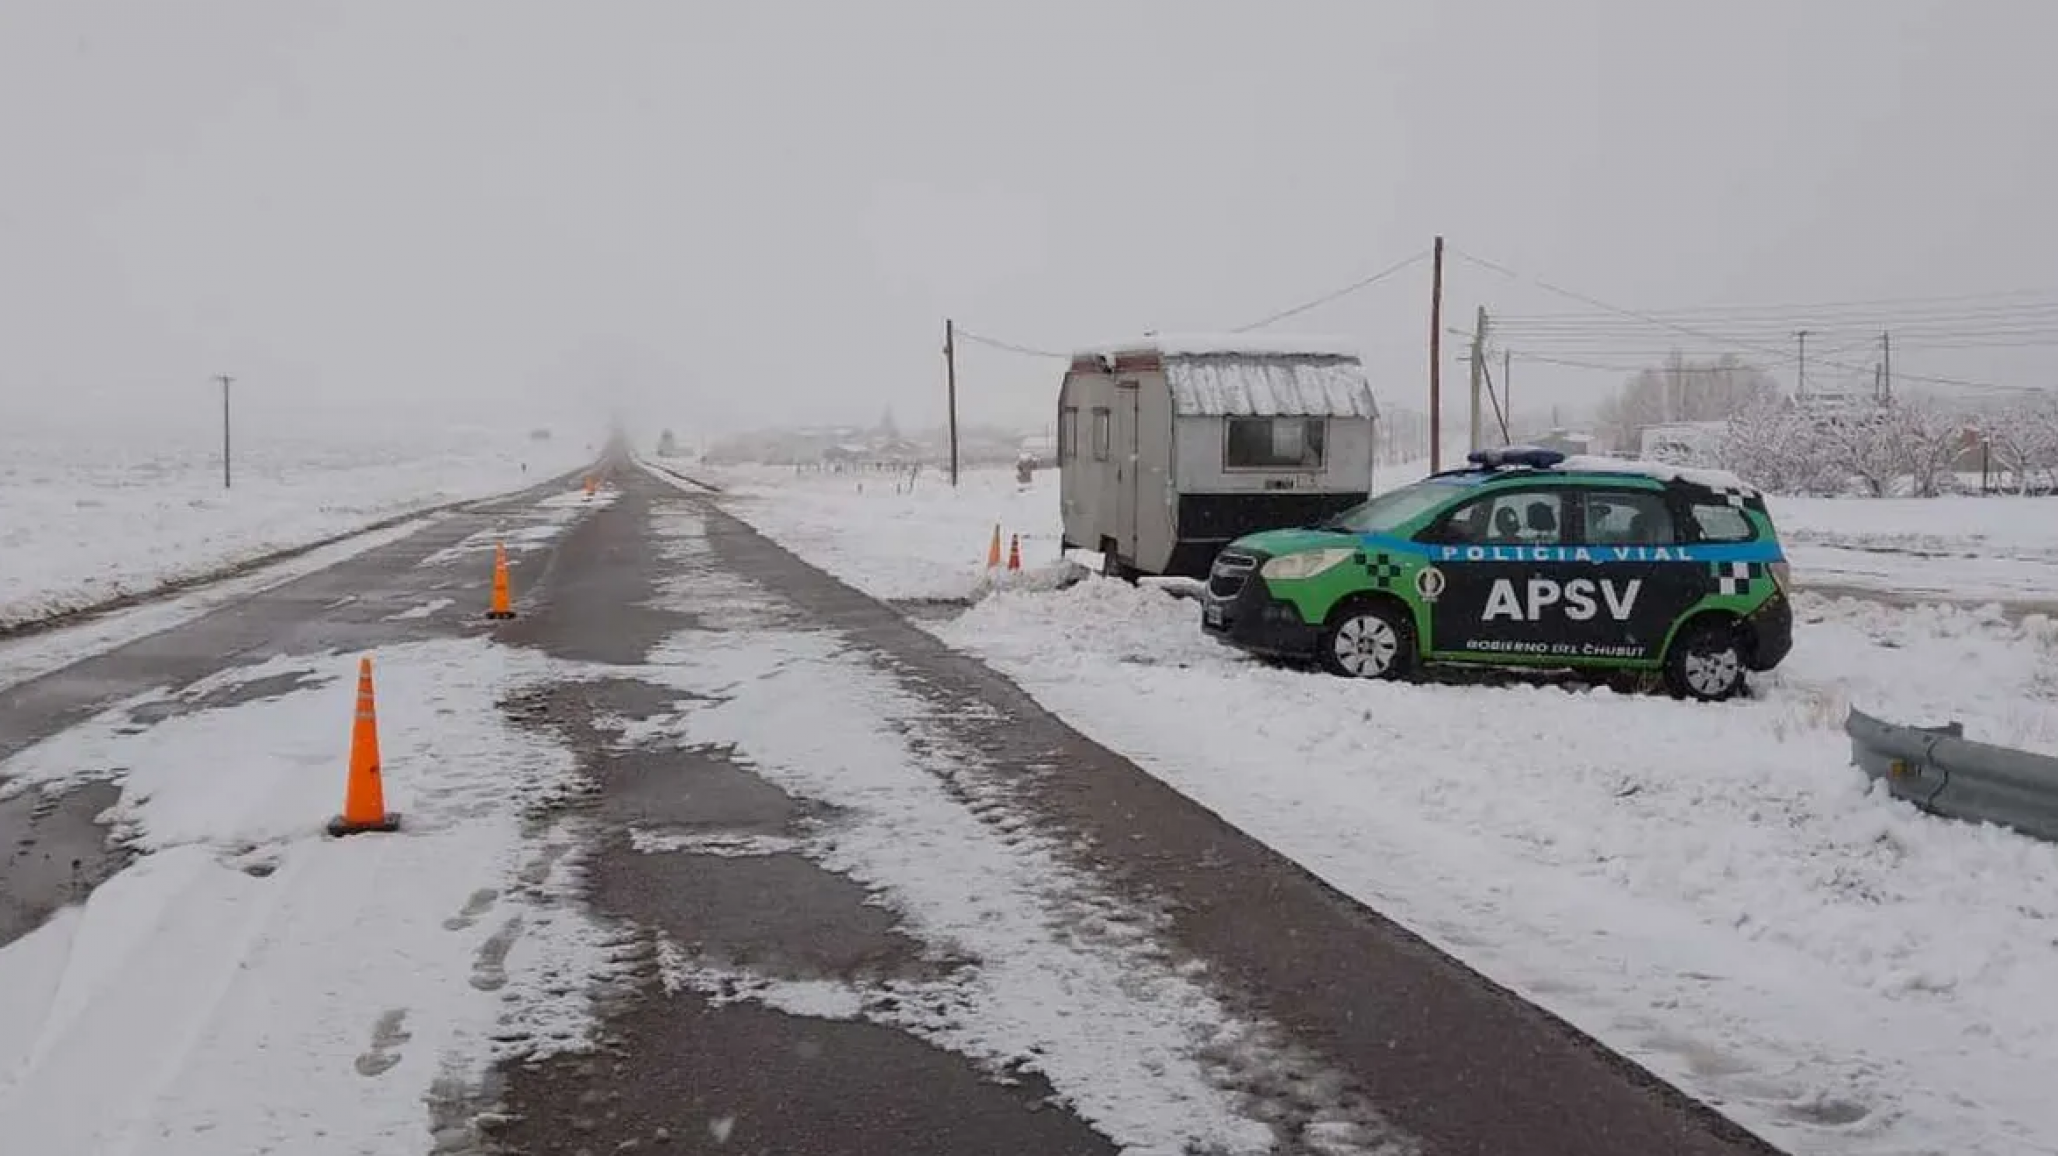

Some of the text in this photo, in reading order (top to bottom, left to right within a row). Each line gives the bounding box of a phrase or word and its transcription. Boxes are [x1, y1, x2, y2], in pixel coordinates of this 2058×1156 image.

[1442, 546, 1693, 561] POLICIA VIAL
[1481, 578, 1642, 620] APSV
[1466, 639, 1646, 657] GOBIERNO DEL CHUBUT
